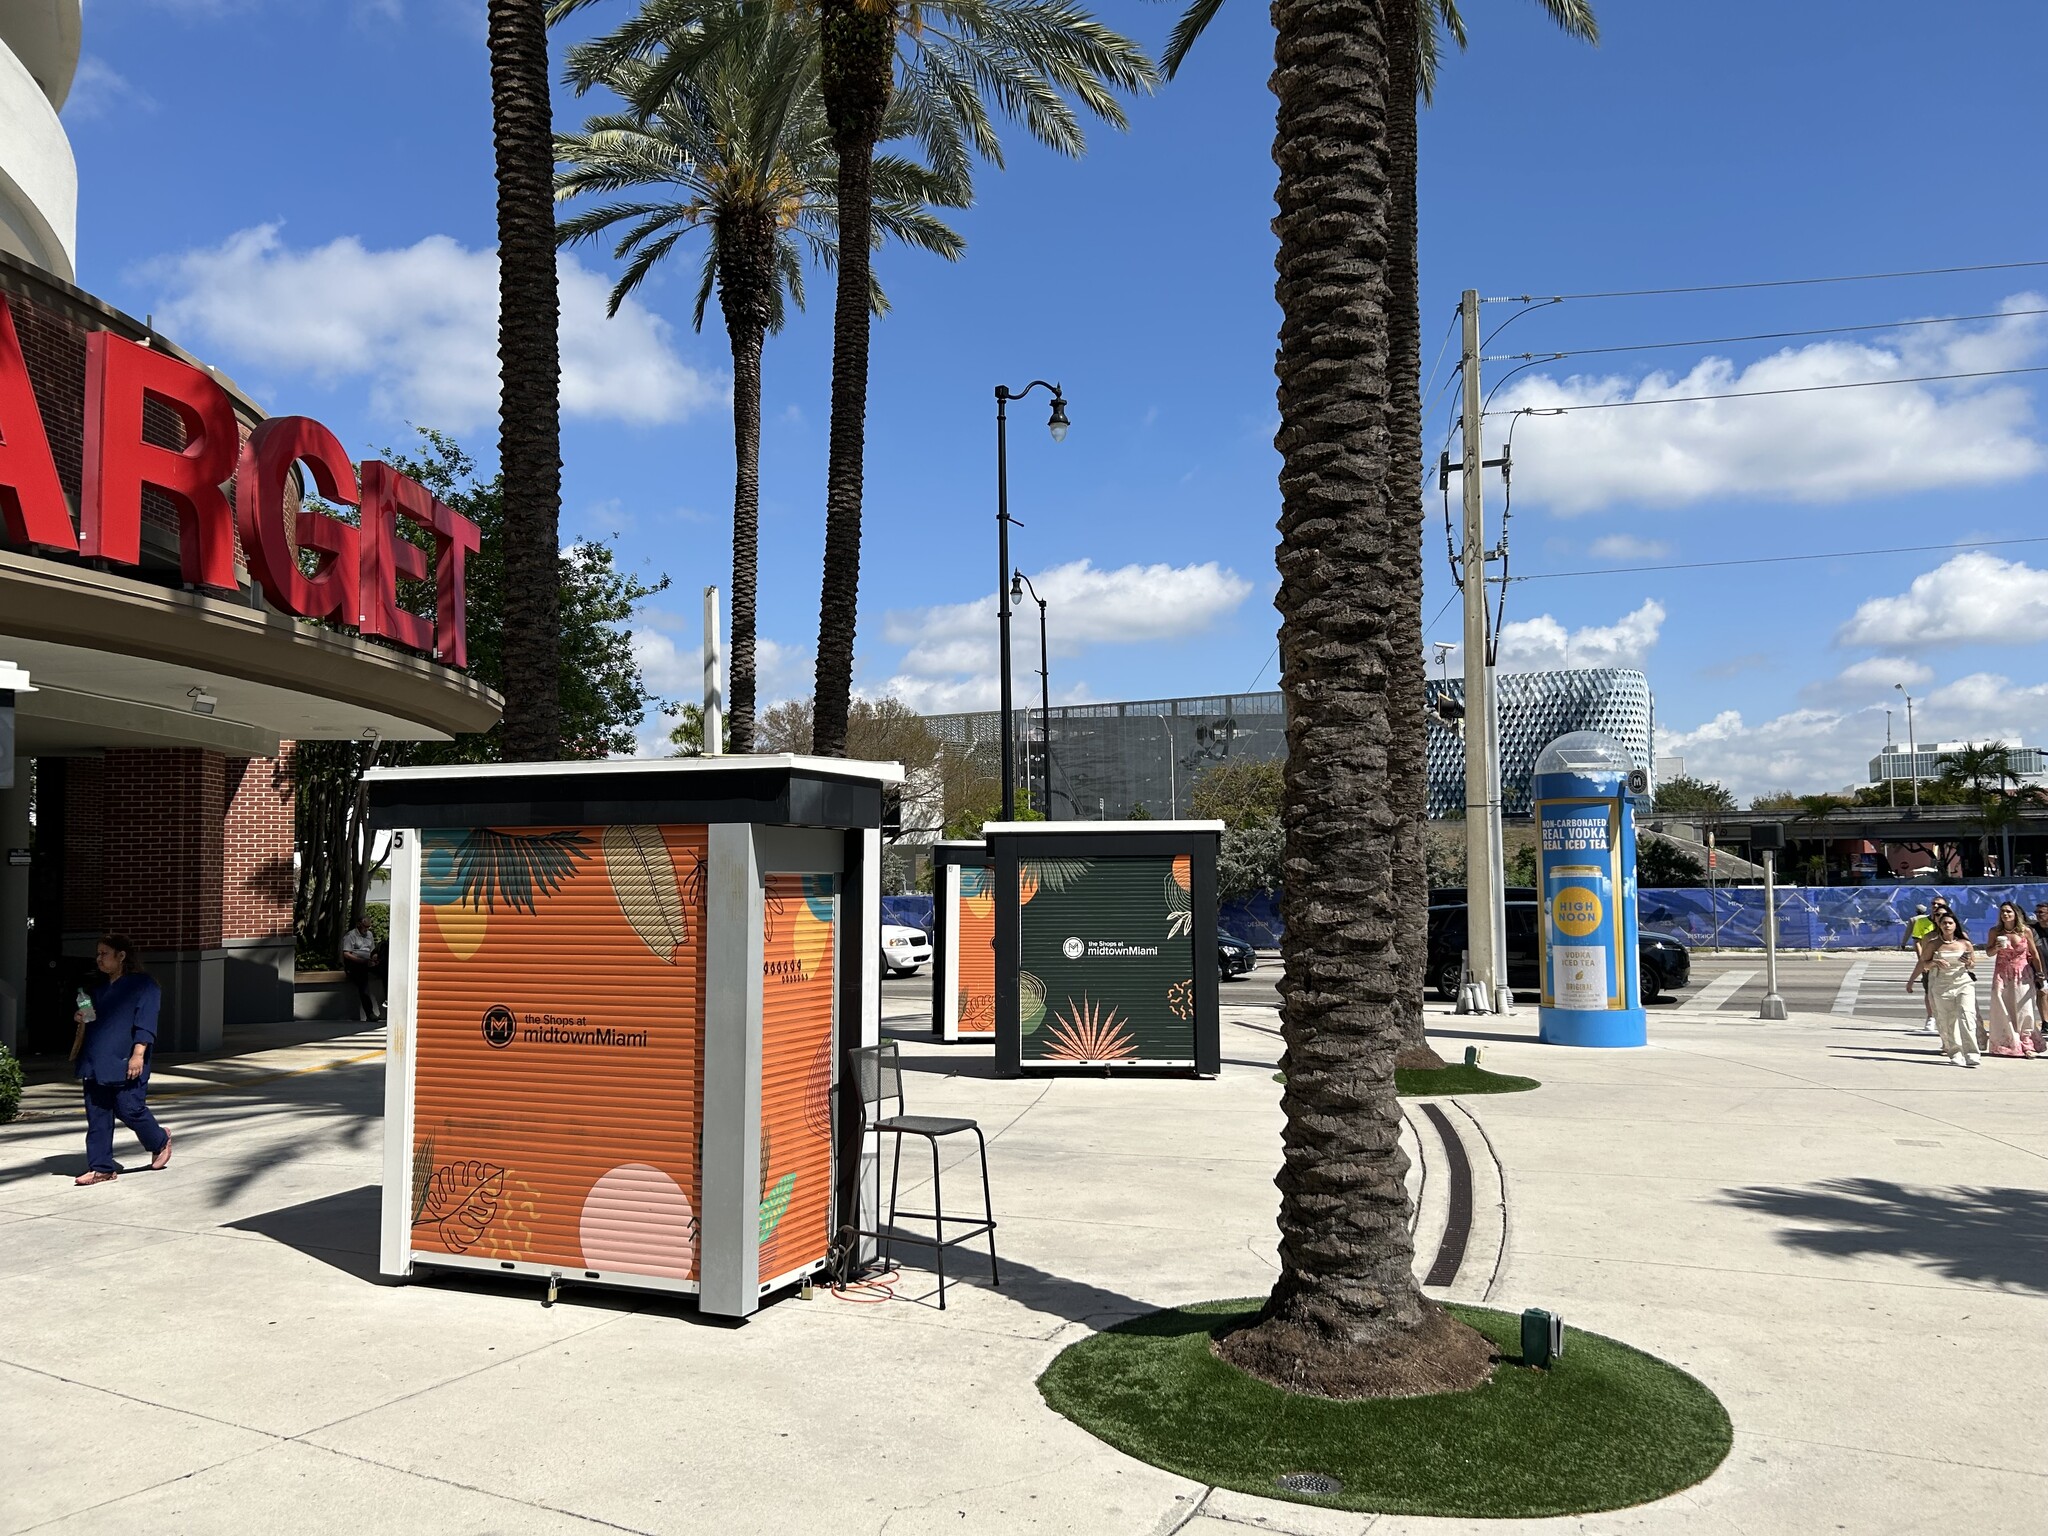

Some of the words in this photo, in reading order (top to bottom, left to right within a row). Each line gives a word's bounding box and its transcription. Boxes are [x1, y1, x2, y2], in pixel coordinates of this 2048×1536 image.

[1542, 819, 1609, 829] NON-CARBONATED.
[1542, 828, 1565, 840] REAL
[1568, 827, 1609, 839] VODKA.
[394, 831, 403, 848] 5
[1543, 840, 1563, 851] REAL
[1565, 840, 1587, 850] ICED
[1589, 839, 1610, 849] TEA.
[1560, 902, 1593, 911] HIGH
[1558, 913, 1595, 921] NOON
[1098, 940, 1117, 948] Shops
[1087, 946, 1158, 956] midtownMiami
[1565, 951, 1591, 959] VODKA
[1581, 959, 1595, 967] TEA
[524, 1014, 541, 1025] the
[543, 1014, 574, 1028] Shops
[576, 1016, 587, 1026] at
[523, 1026, 648, 1048] midtownMiami
